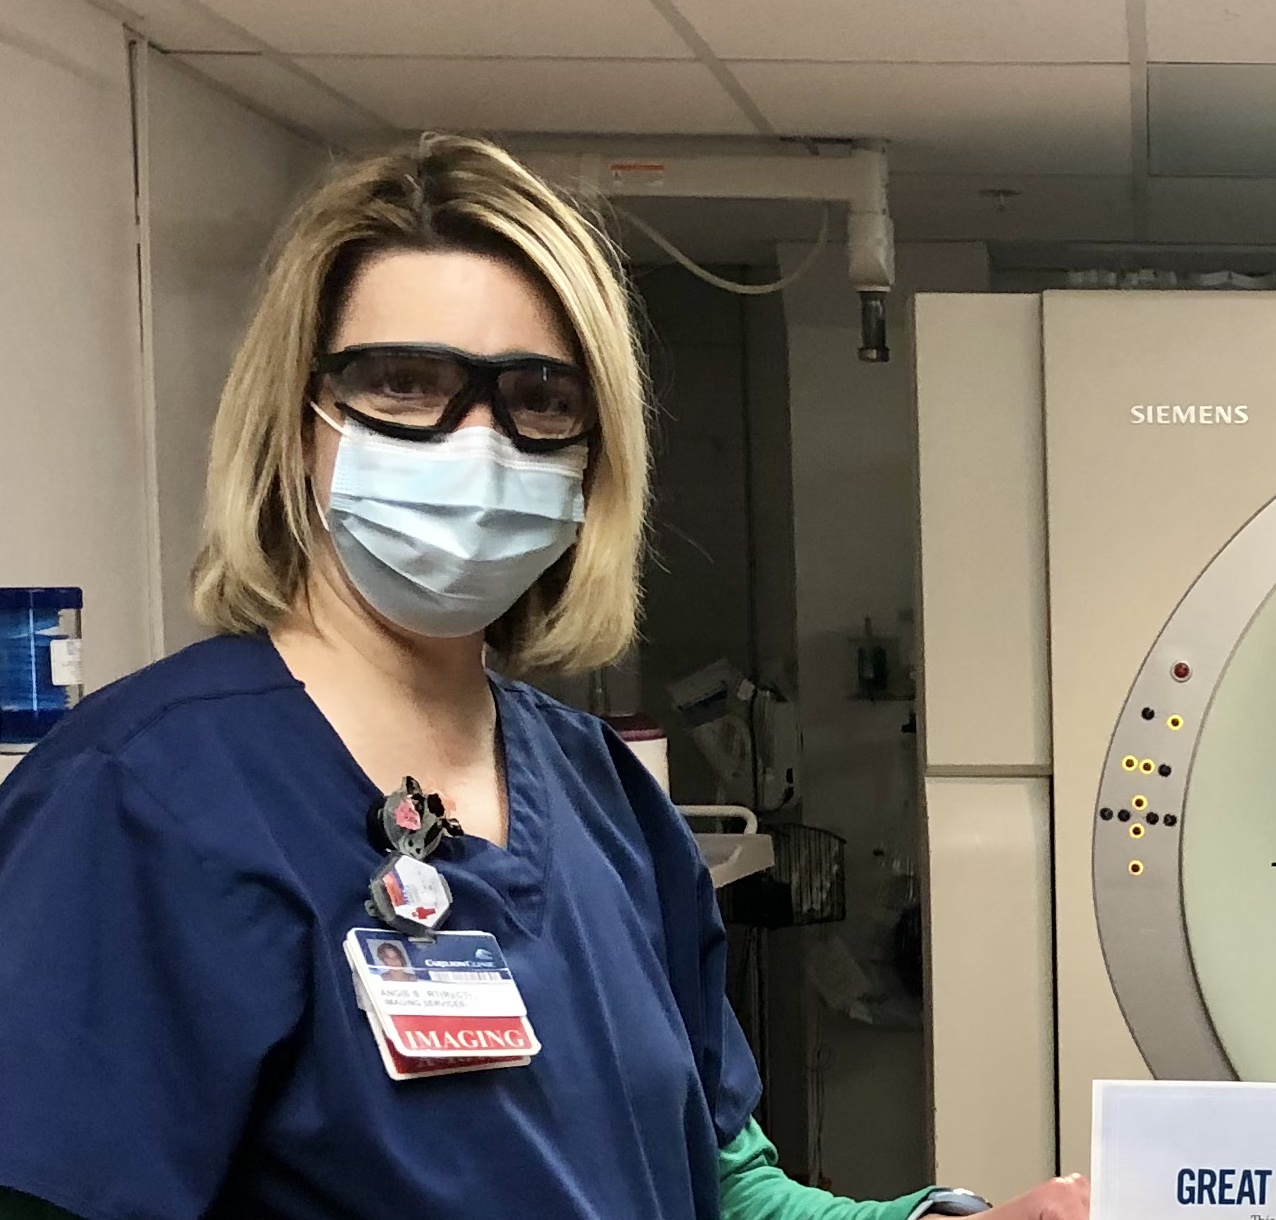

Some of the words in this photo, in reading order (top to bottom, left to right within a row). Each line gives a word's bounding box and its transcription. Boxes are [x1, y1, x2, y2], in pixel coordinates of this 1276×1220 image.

[1130, 405, 1249, 424] SIEMENS
[405, 1030, 524, 1048] IMAGING
[1176, 1168, 1272, 1205] GREAT
